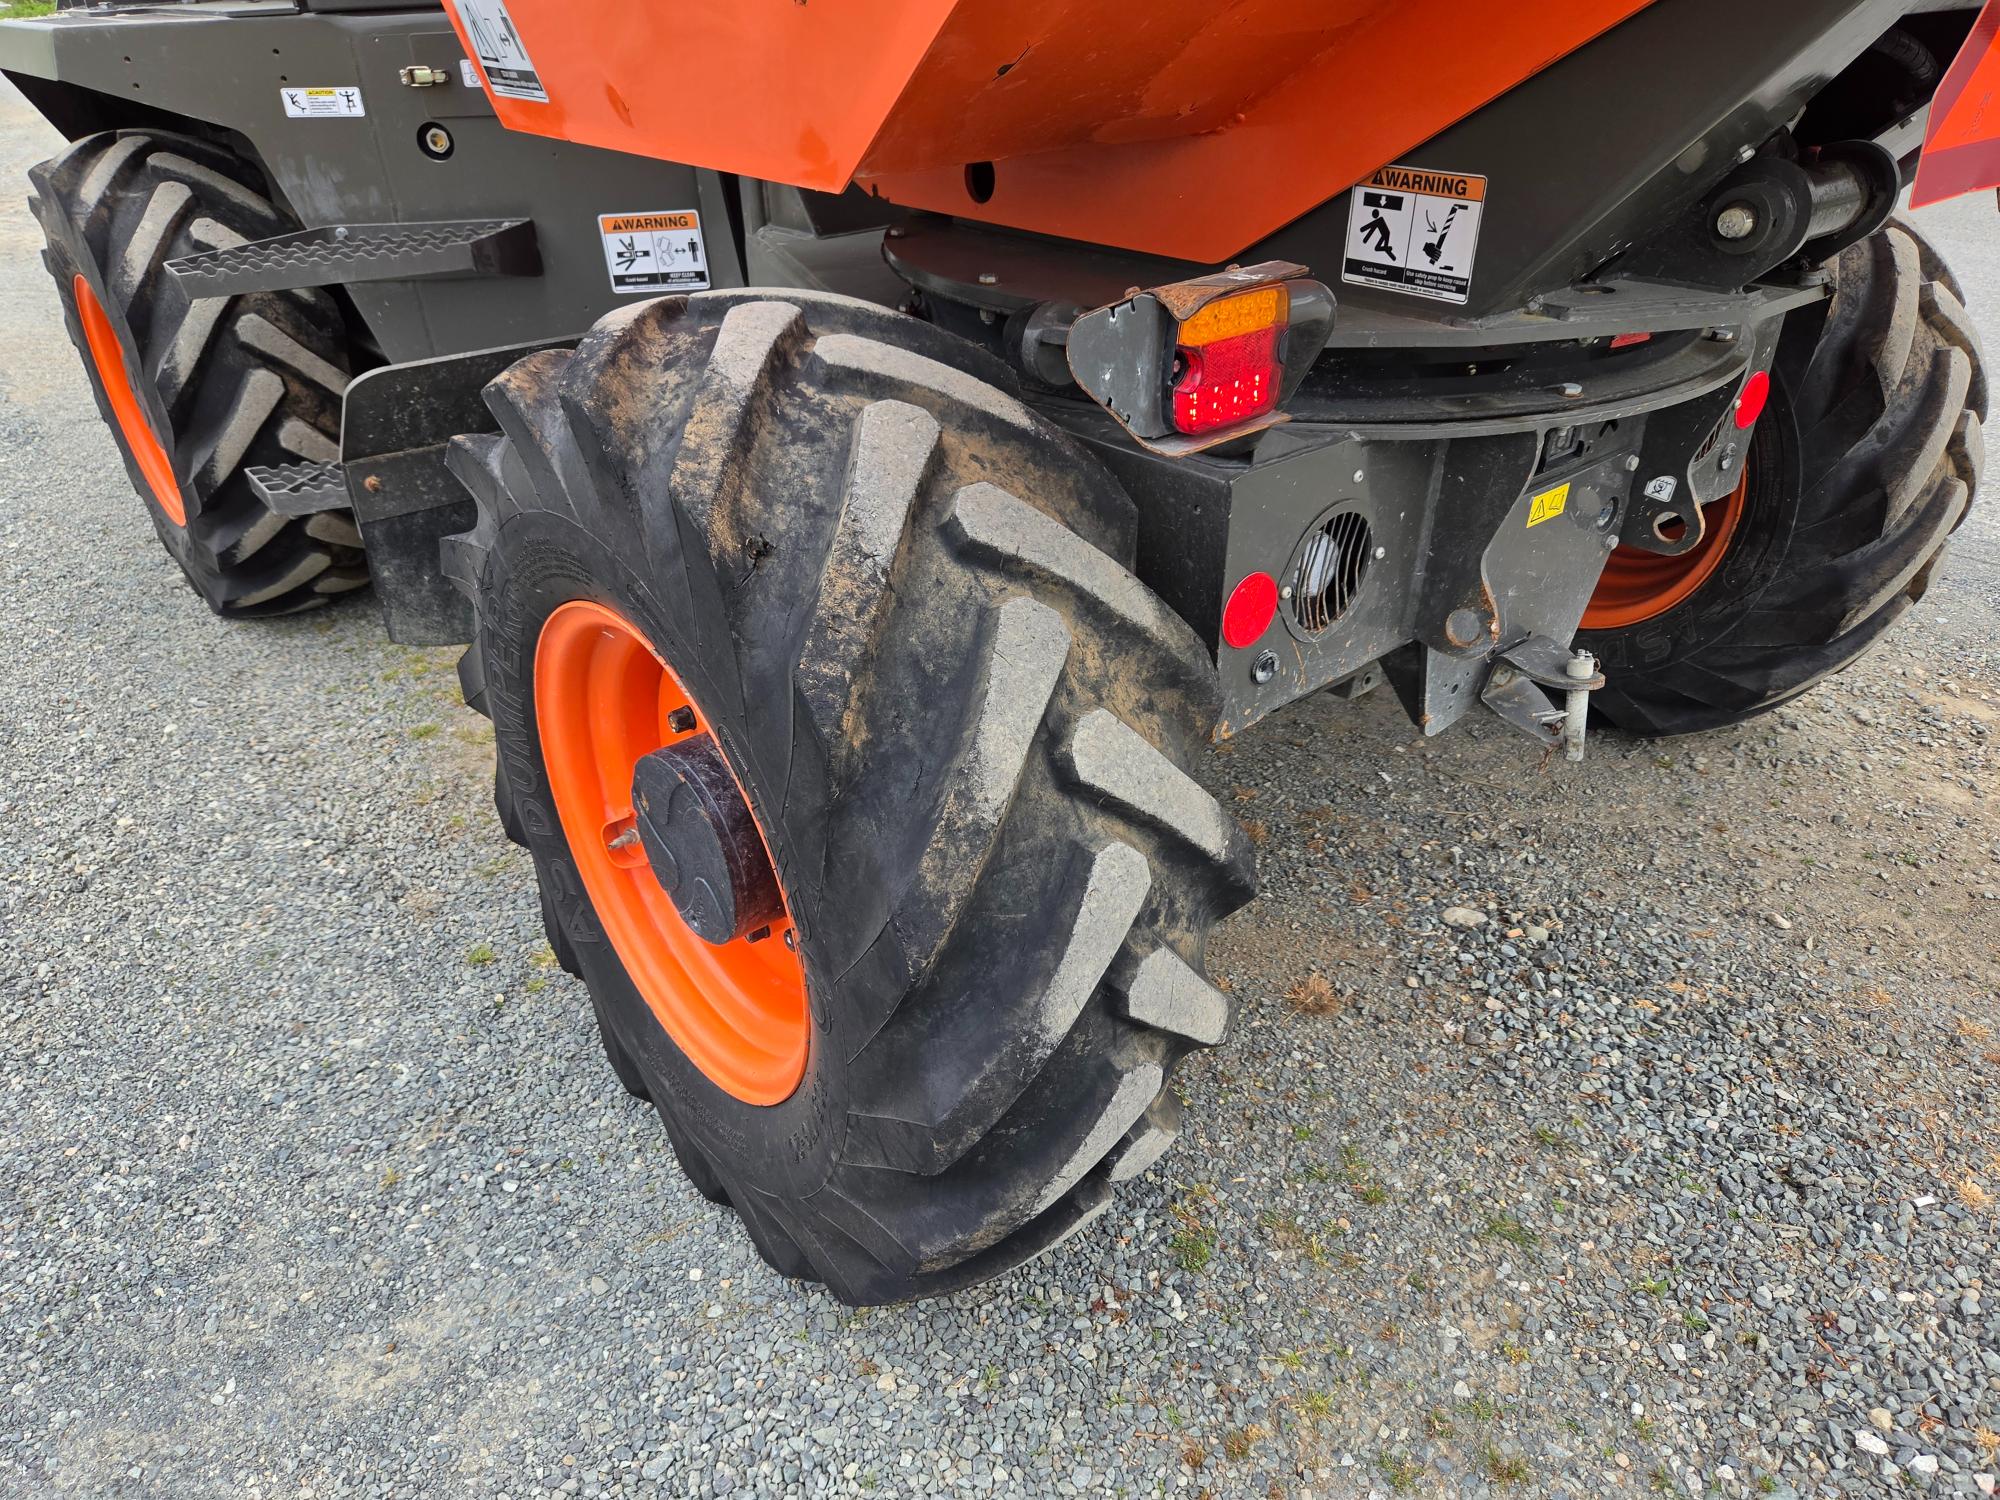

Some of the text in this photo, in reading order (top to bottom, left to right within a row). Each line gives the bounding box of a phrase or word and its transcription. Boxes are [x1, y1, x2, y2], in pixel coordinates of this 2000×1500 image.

[1385, 169, 1467, 196] WARNING
[622, 216, 689, 231] WARNING
[1415, 272, 1428, 280] safety
